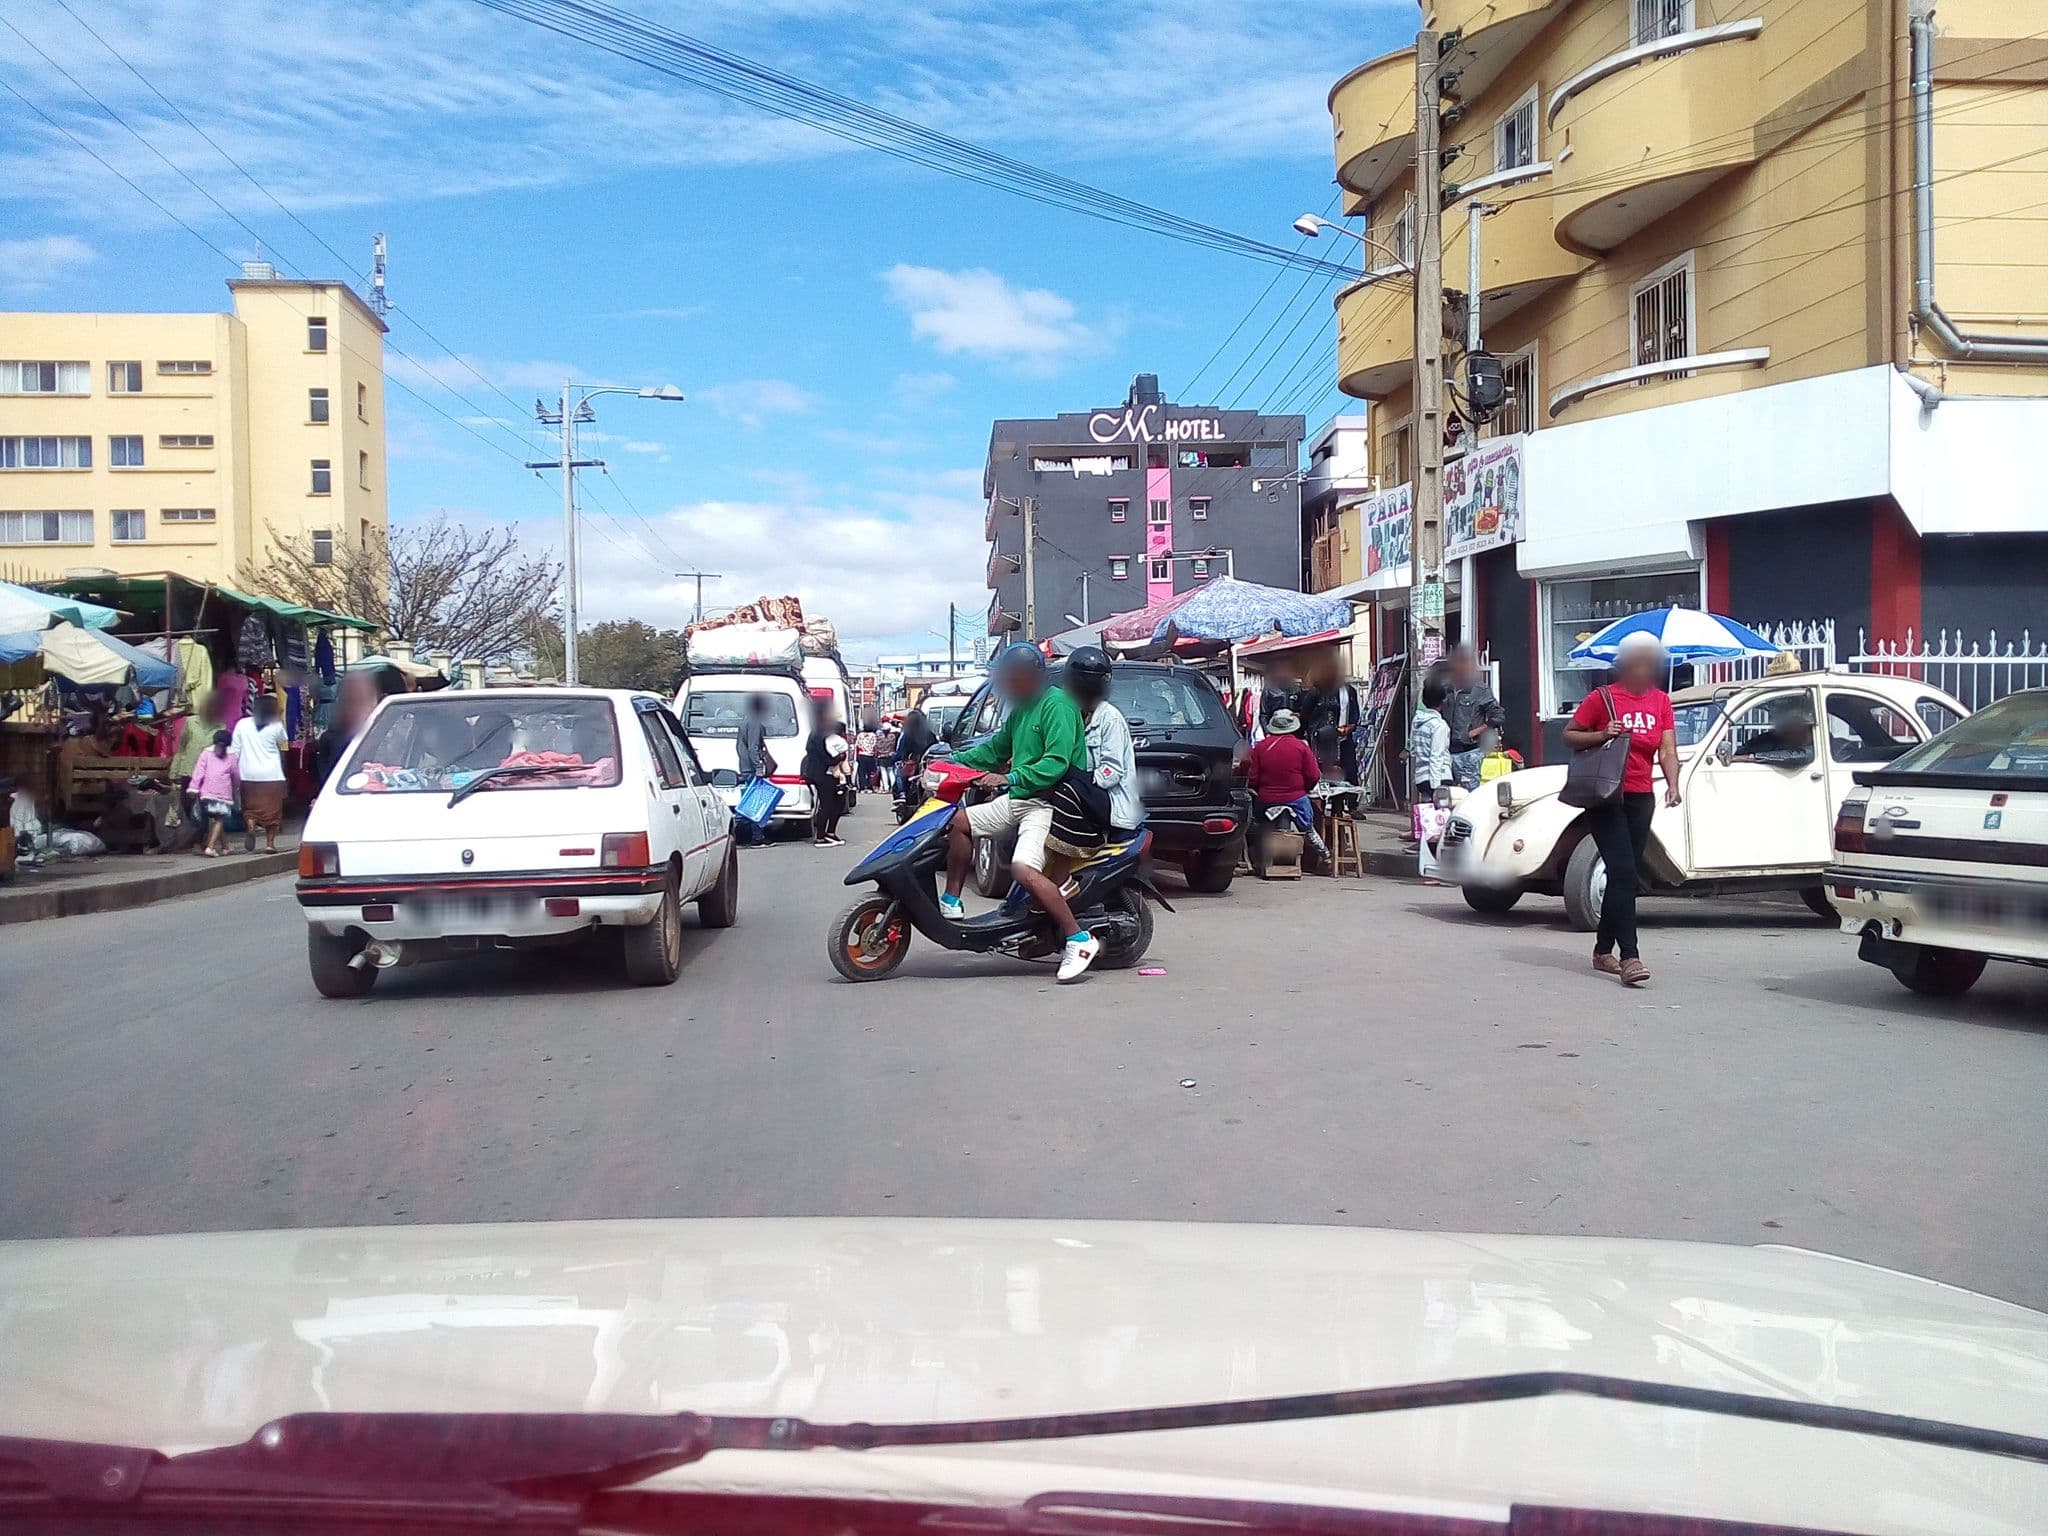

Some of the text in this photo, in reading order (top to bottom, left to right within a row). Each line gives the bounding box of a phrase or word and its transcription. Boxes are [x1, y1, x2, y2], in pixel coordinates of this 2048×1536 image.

[1165, 419, 1226, 440] HOTEL
[1368, 488, 1411, 526] PARA
[1622, 711, 1656, 730] GAP
